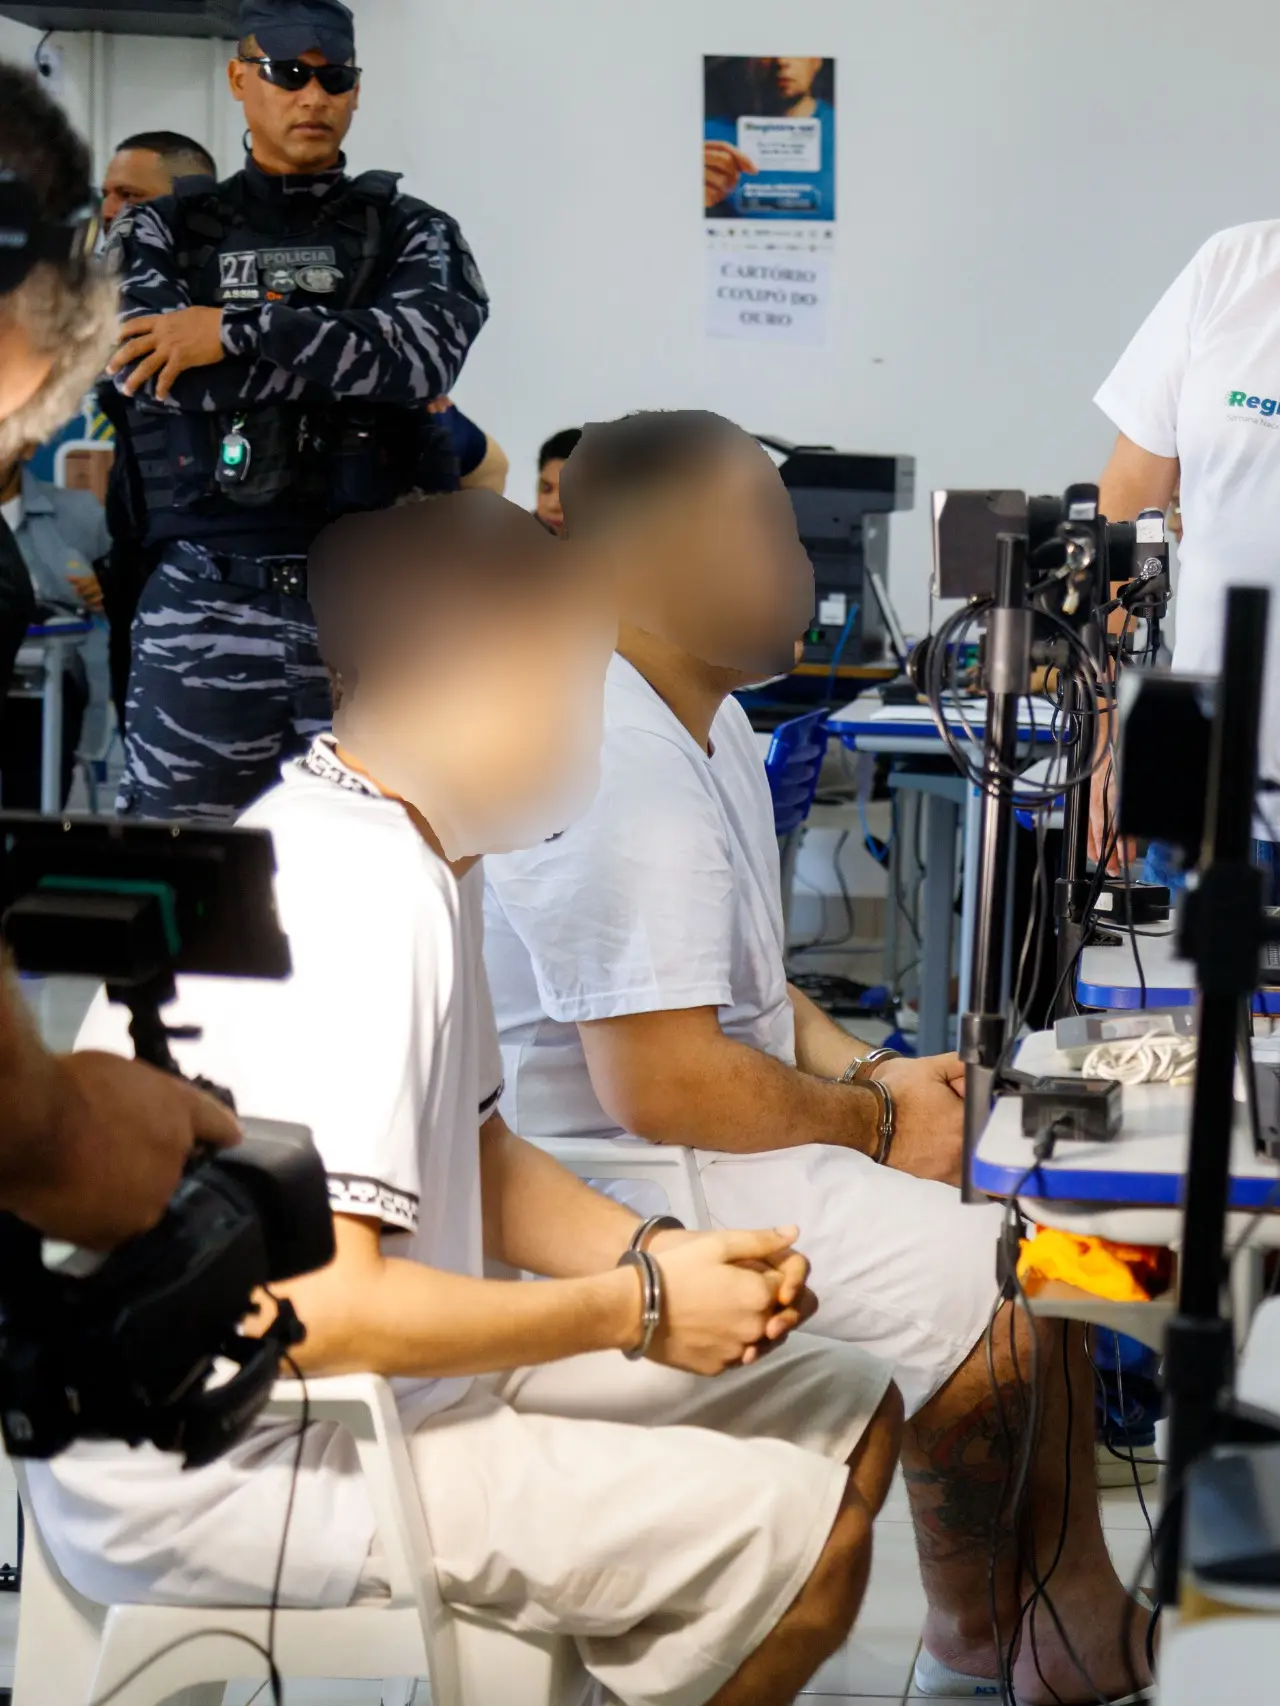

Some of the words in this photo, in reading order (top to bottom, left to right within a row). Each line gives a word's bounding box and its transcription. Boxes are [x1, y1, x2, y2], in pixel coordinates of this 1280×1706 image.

[222, 254, 256, 285] 27
[720, 261, 817, 284] CARTÓRIO
[790, 291, 818, 306] DO
[739, 311, 794, 328] OURO
